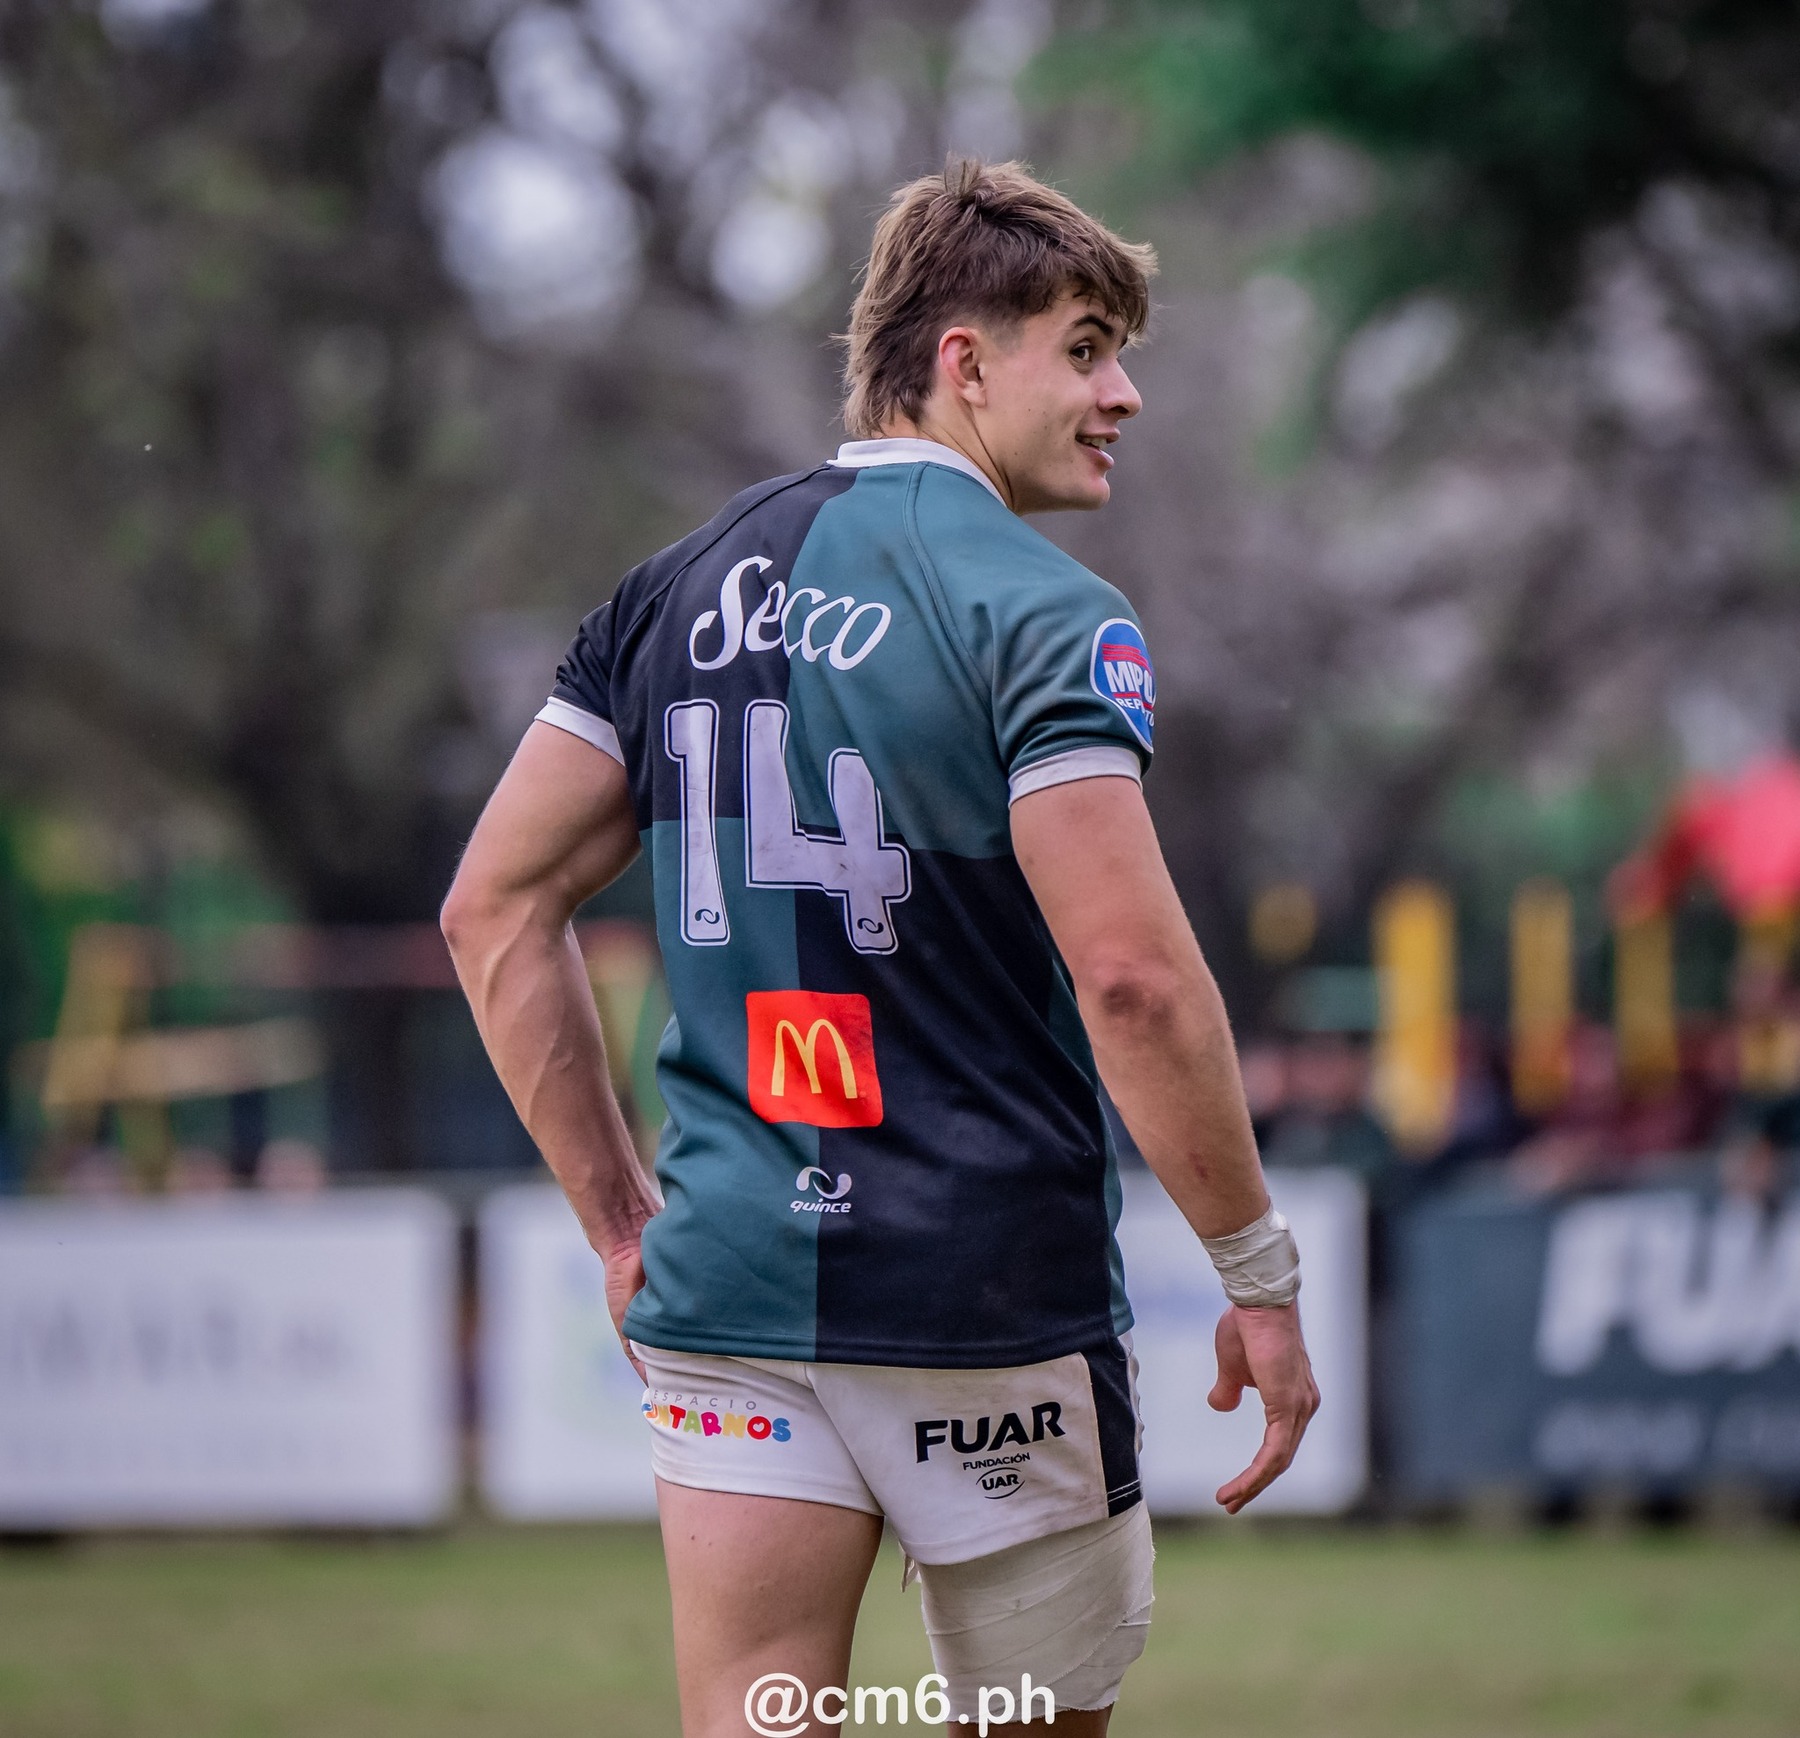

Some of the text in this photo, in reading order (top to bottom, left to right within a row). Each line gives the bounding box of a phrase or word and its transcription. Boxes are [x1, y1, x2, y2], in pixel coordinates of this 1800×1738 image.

[689, 556, 891, 670] Secco
[664, 699, 912, 955] 14
[790, 1198, 852, 1213] quince
[654, 1390, 757, 1410] ESPACIO
[915, 1402, 1066, 1464] FUAR
[963, 1452, 1031, 1471] FUNDACIÓN
[982, 1473, 1020, 1490] UAR
